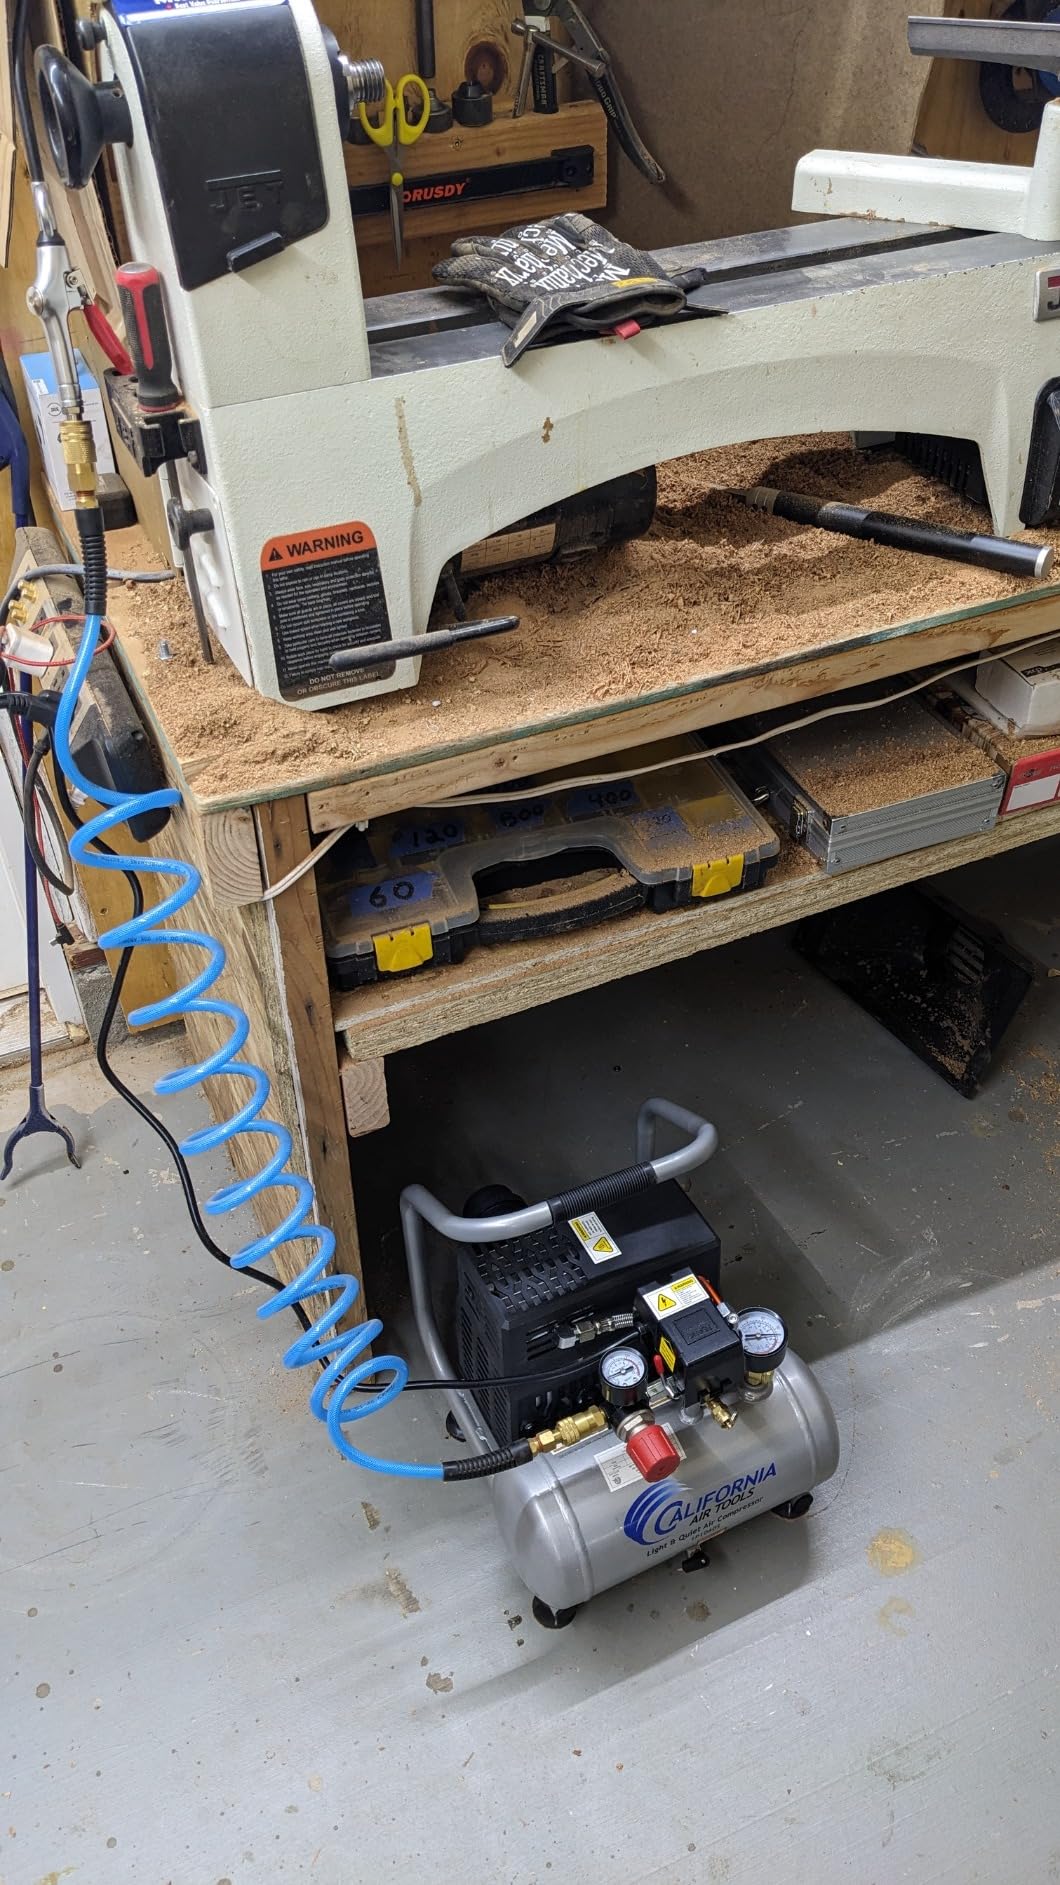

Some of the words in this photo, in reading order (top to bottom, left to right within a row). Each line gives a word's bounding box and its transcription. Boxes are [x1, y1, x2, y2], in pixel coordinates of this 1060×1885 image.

[402, 182, 466, 204] ORUSDY
[286, 530, 364, 558] WARNING
[308, 679, 342, 693] OBSCURE
[309, 675, 321, 685] DO
[321, 672, 335, 683] NOT
[335, 667, 366, 680] REMOVE
[588, 788, 632, 808] 400
[412, 824, 458, 848] 120
[368, 881, 415, 908] 60
[654, 1463, 777, 1536] CALIFORNIA
[689, 1508, 712, 1527] AIR
[715, 1487, 756, 1514] TOOLS
[646, 1543, 668, 1557] Light
[678, 1527, 702, 1542] Quiet
[703, 1519, 716, 1529] Air
[717, 1496, 764, 1523] Compressor
